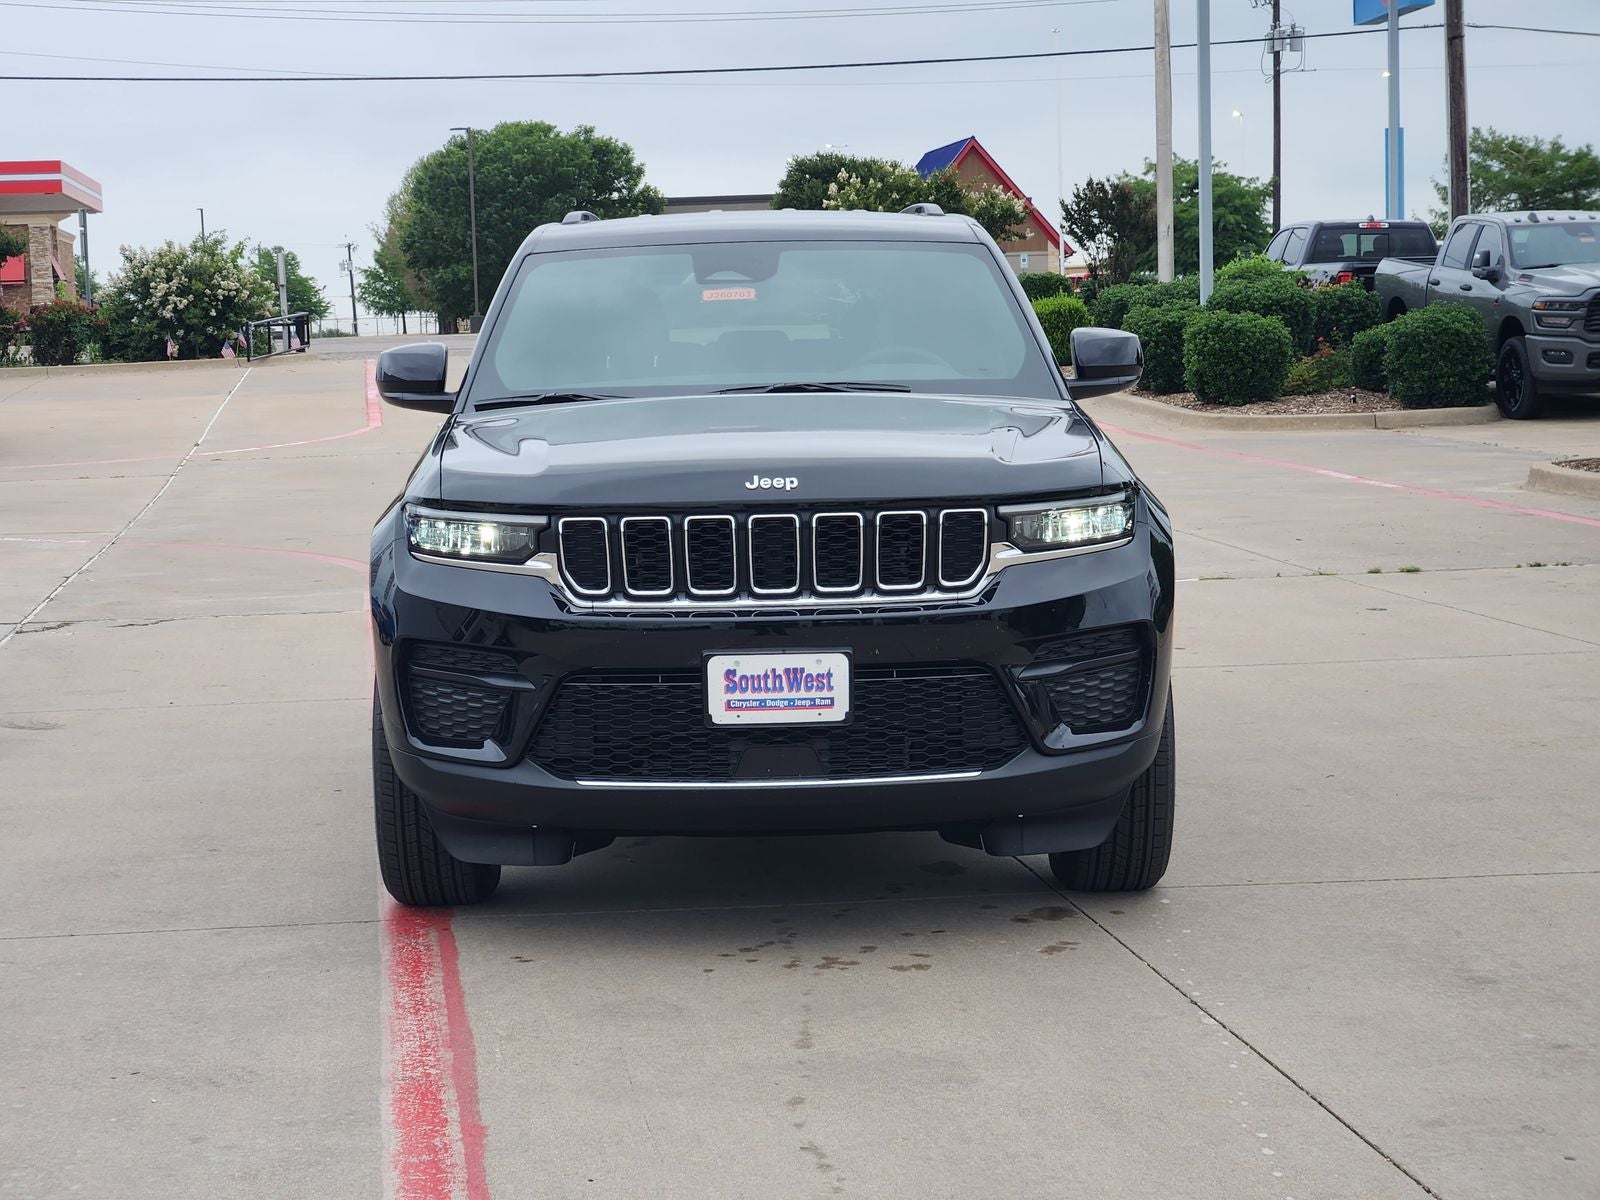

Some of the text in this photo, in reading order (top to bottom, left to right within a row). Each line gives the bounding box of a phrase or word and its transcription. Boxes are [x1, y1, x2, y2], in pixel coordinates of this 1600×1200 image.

[745, 475, 799, 491] Jeep
[724, 667, 834, 694] SouthWest
[730, 698, 831, 708] Chrysler Dodge Jeep Ram
